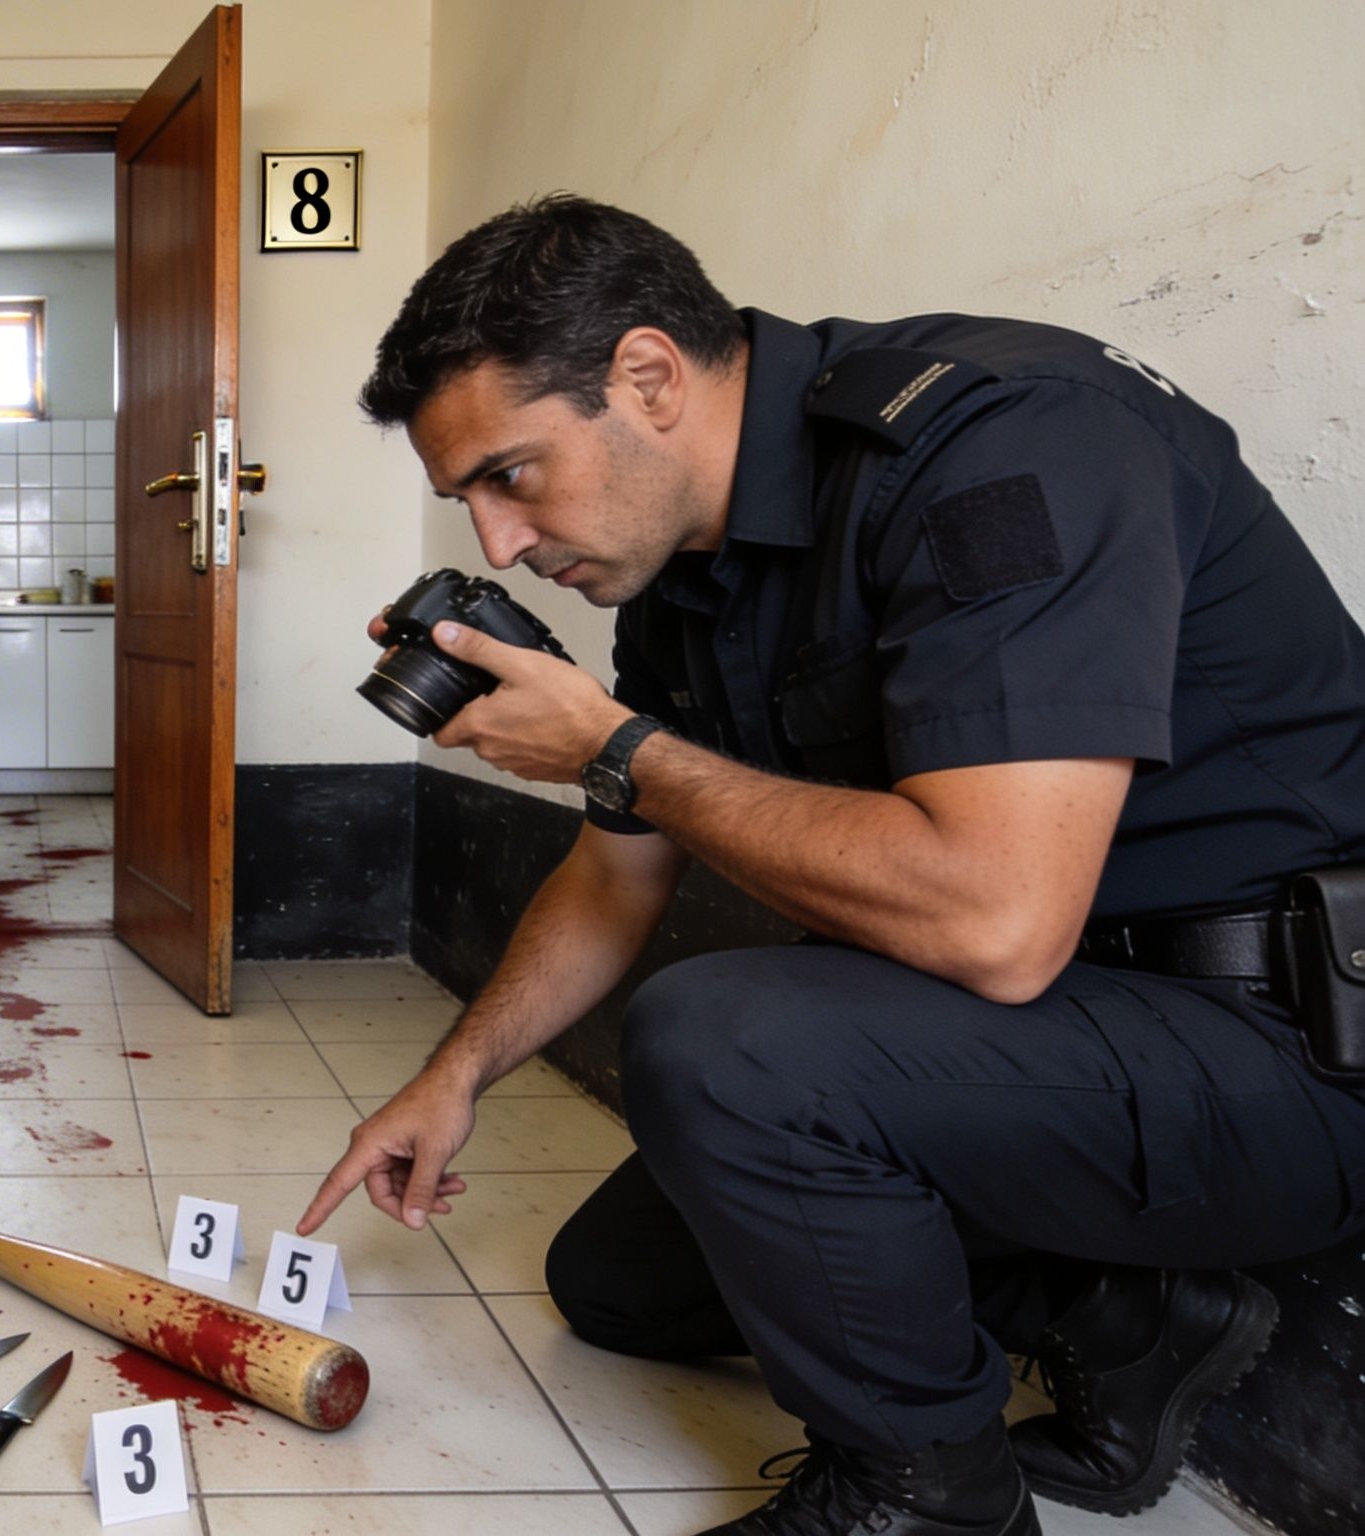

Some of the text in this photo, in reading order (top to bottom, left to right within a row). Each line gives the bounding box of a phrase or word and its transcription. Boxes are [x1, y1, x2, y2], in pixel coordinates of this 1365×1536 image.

[290, 168, 331, 235] 8
[190, 1212, 216, 1260] 3
[282, 1250, 313, 1304] 5
[122, 1424, 157, 1495] 3
